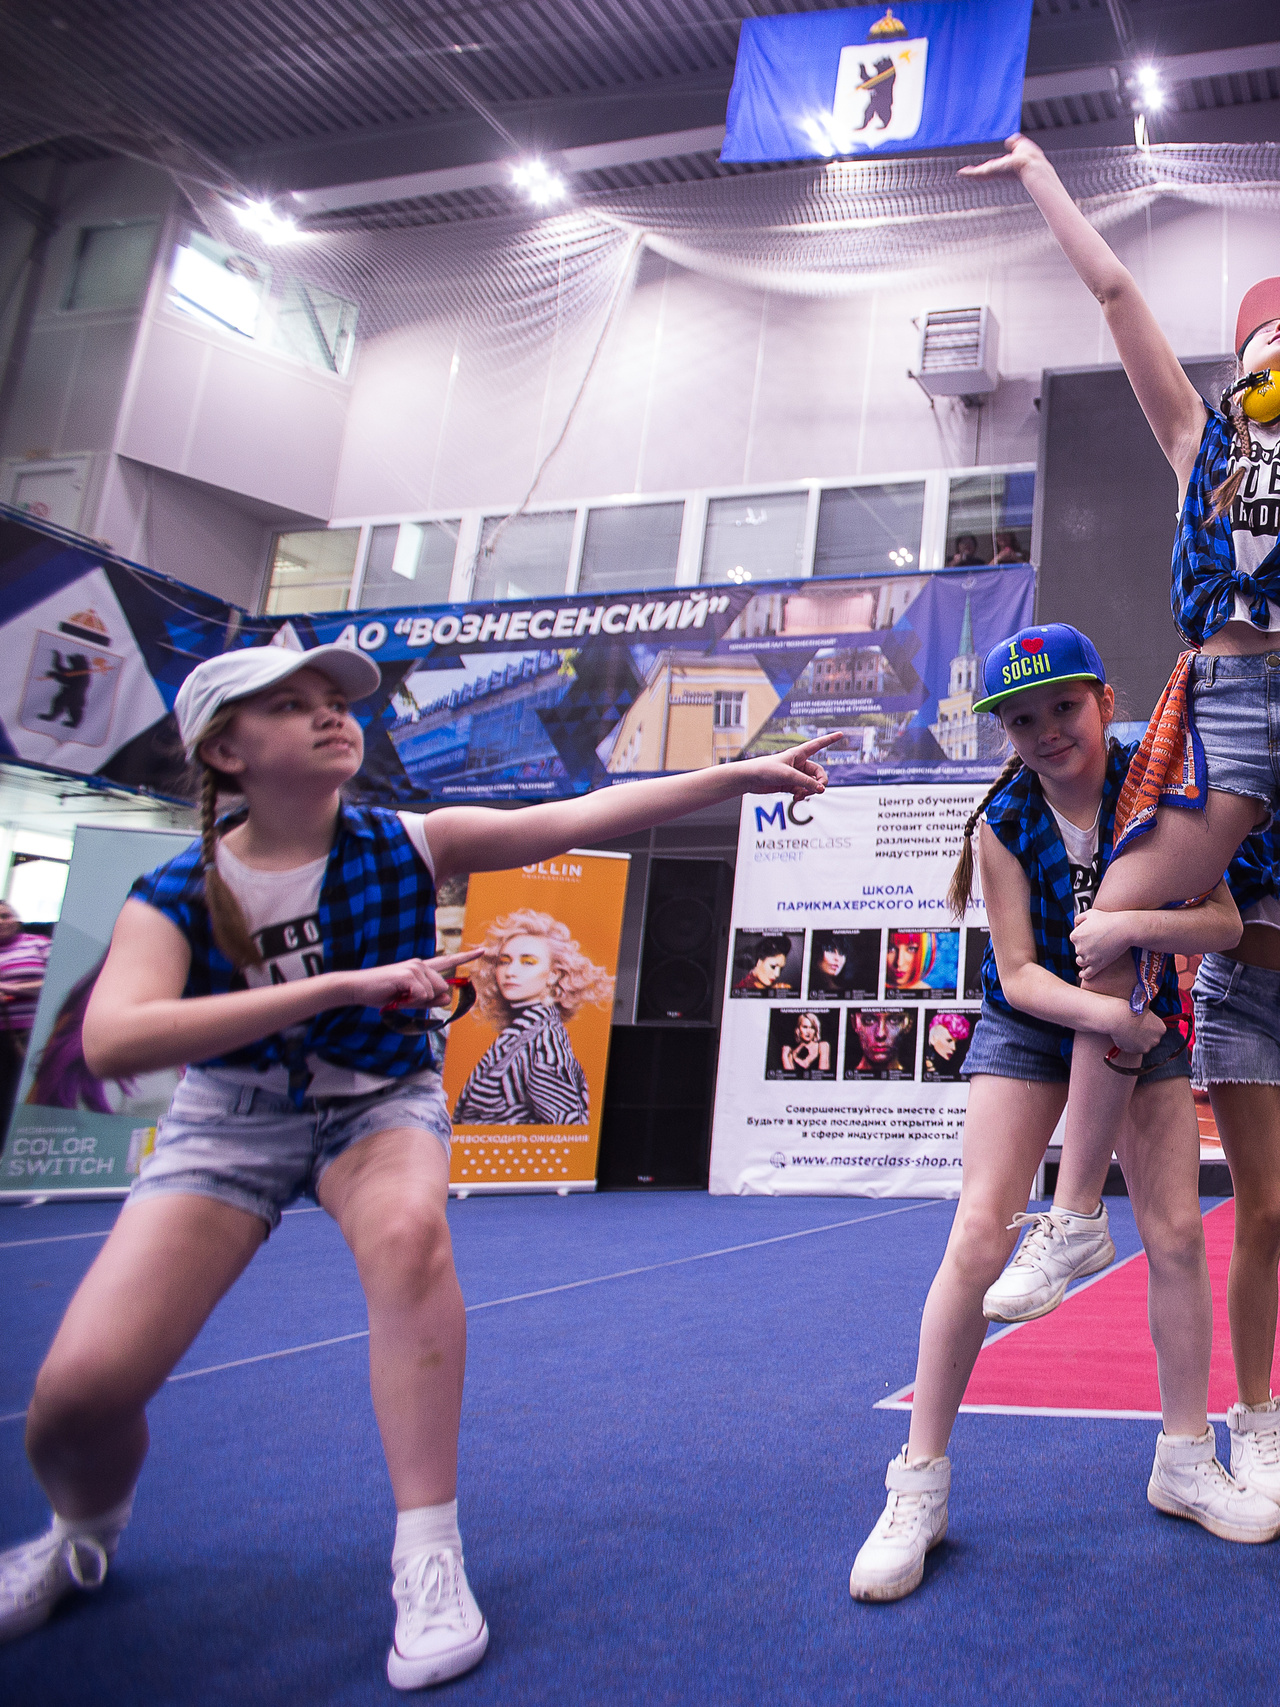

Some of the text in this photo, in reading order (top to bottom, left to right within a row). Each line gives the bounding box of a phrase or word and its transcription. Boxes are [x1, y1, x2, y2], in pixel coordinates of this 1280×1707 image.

[1008, 641, 1018, 661] I
[1002, 652, 1051, 685] SOCHI
[878, 796, 975, 807] Центр обучения
[877, 811, 935, 819] компании
[876, 823, 922, 832] готовит
[875, 836, 941, 847] различных
[875, 850, 938, 858] индустрии
[862, 885, 914, 896] ШКОЛА
[777, 899, 914, 912] ПАРИКМАХЕРСКОГО
[785, 1104, 894, 1116] Совершенствуйтесь
[896, 1106, 936, 1114] вместе
[746, 1116, 785, 1127] Будьте
[787, 1118, 794, 1126] в
[796, 1118, 828, 1128] курсе
[830, 1117, 887, 1127] последних
[889, 1117, 944, 1128] открытий
[529, 1134, 589, 1144] ОЖИДАНИЯ
[801, 1130, 959, 1141] в сфере индустрии красоты!
[13, 1137, 99, 1156] COLOR
[7, 1156, 116, 1176] SWITCH
